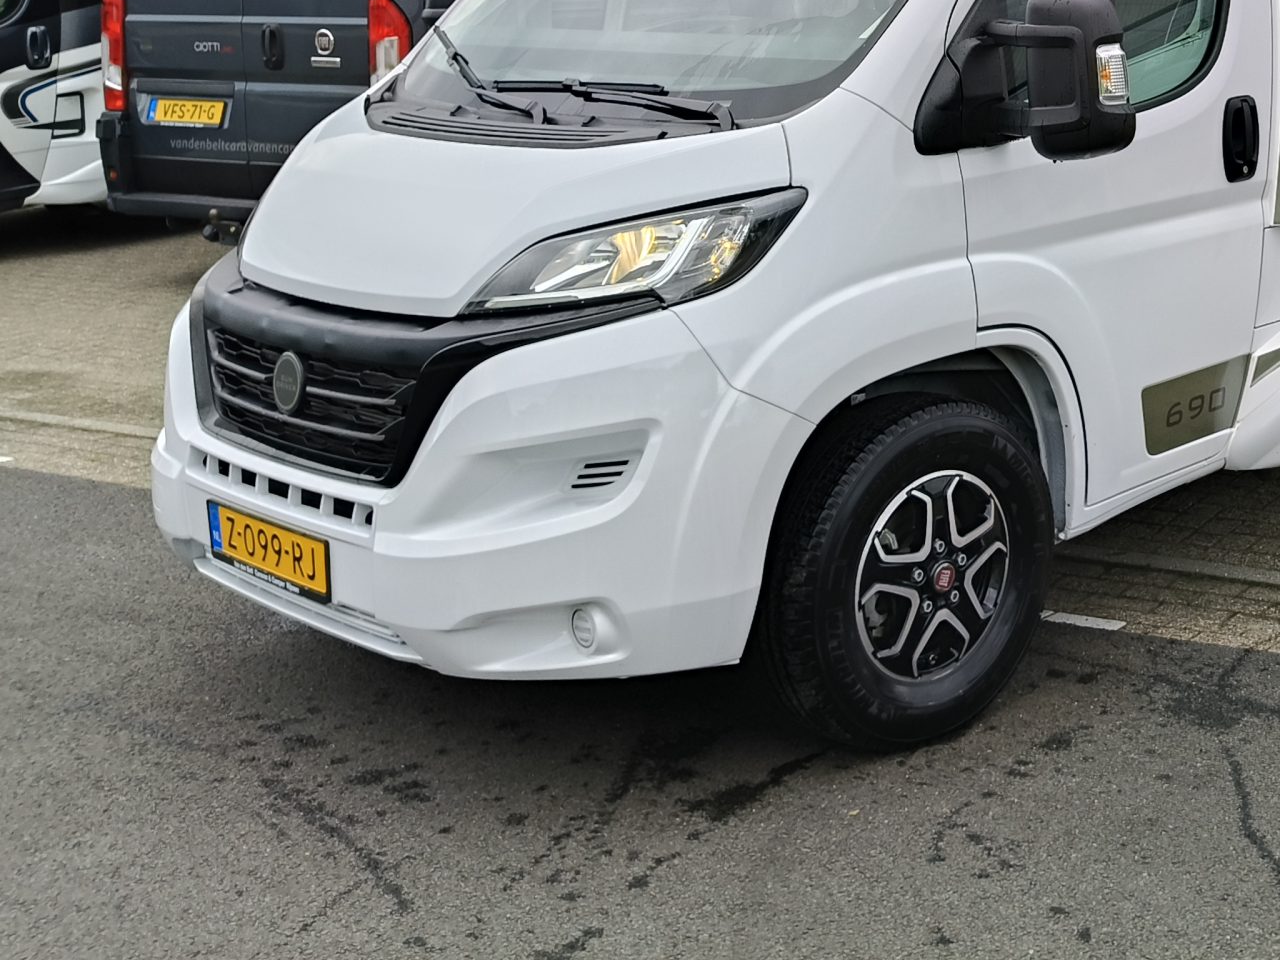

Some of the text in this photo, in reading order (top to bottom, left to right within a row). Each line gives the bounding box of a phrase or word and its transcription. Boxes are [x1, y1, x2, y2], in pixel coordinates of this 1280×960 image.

[163, 102, 215, 121] VFS-71-G
[1166, 386, 1226, 428] 690
[226, 516, 316, 581] Z-099-RJ
